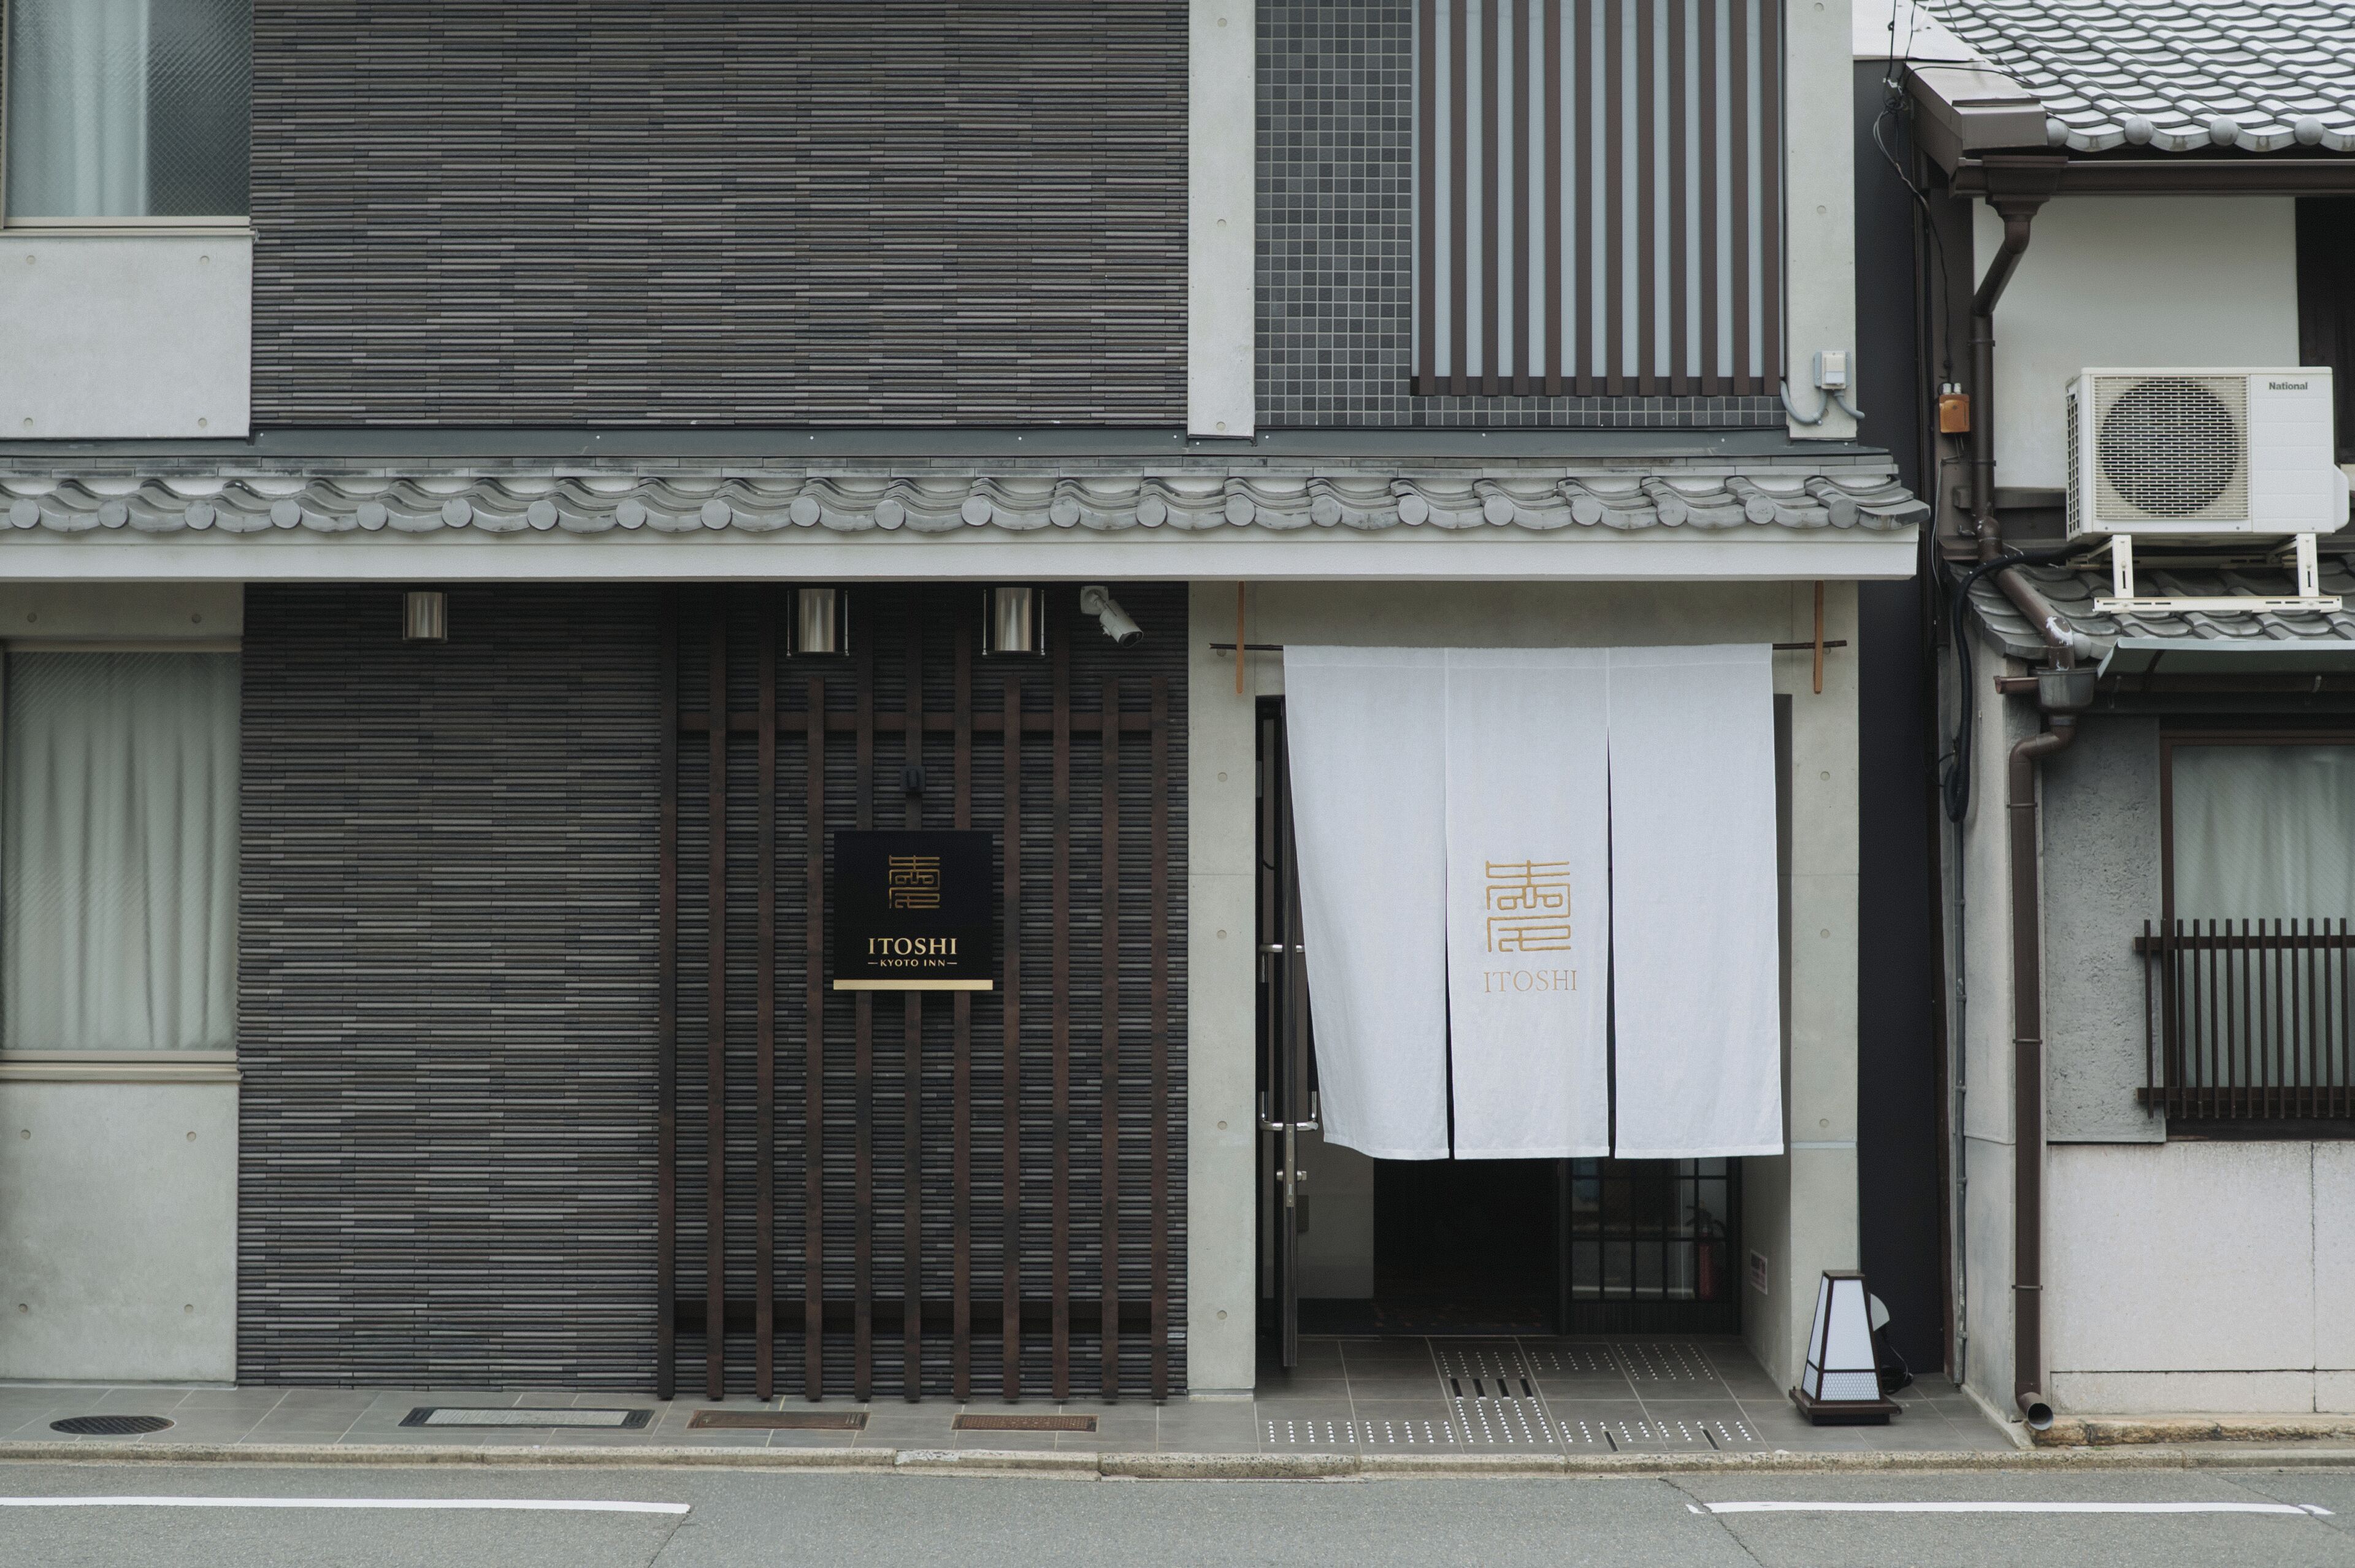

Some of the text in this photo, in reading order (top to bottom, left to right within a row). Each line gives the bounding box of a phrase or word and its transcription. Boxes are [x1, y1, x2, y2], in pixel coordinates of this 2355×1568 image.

[868, 938, 957, 955] ITOSHI
[880, 958, 919, 967] KYOTO
[1483, 969, 1577, 993] ITOSHI
